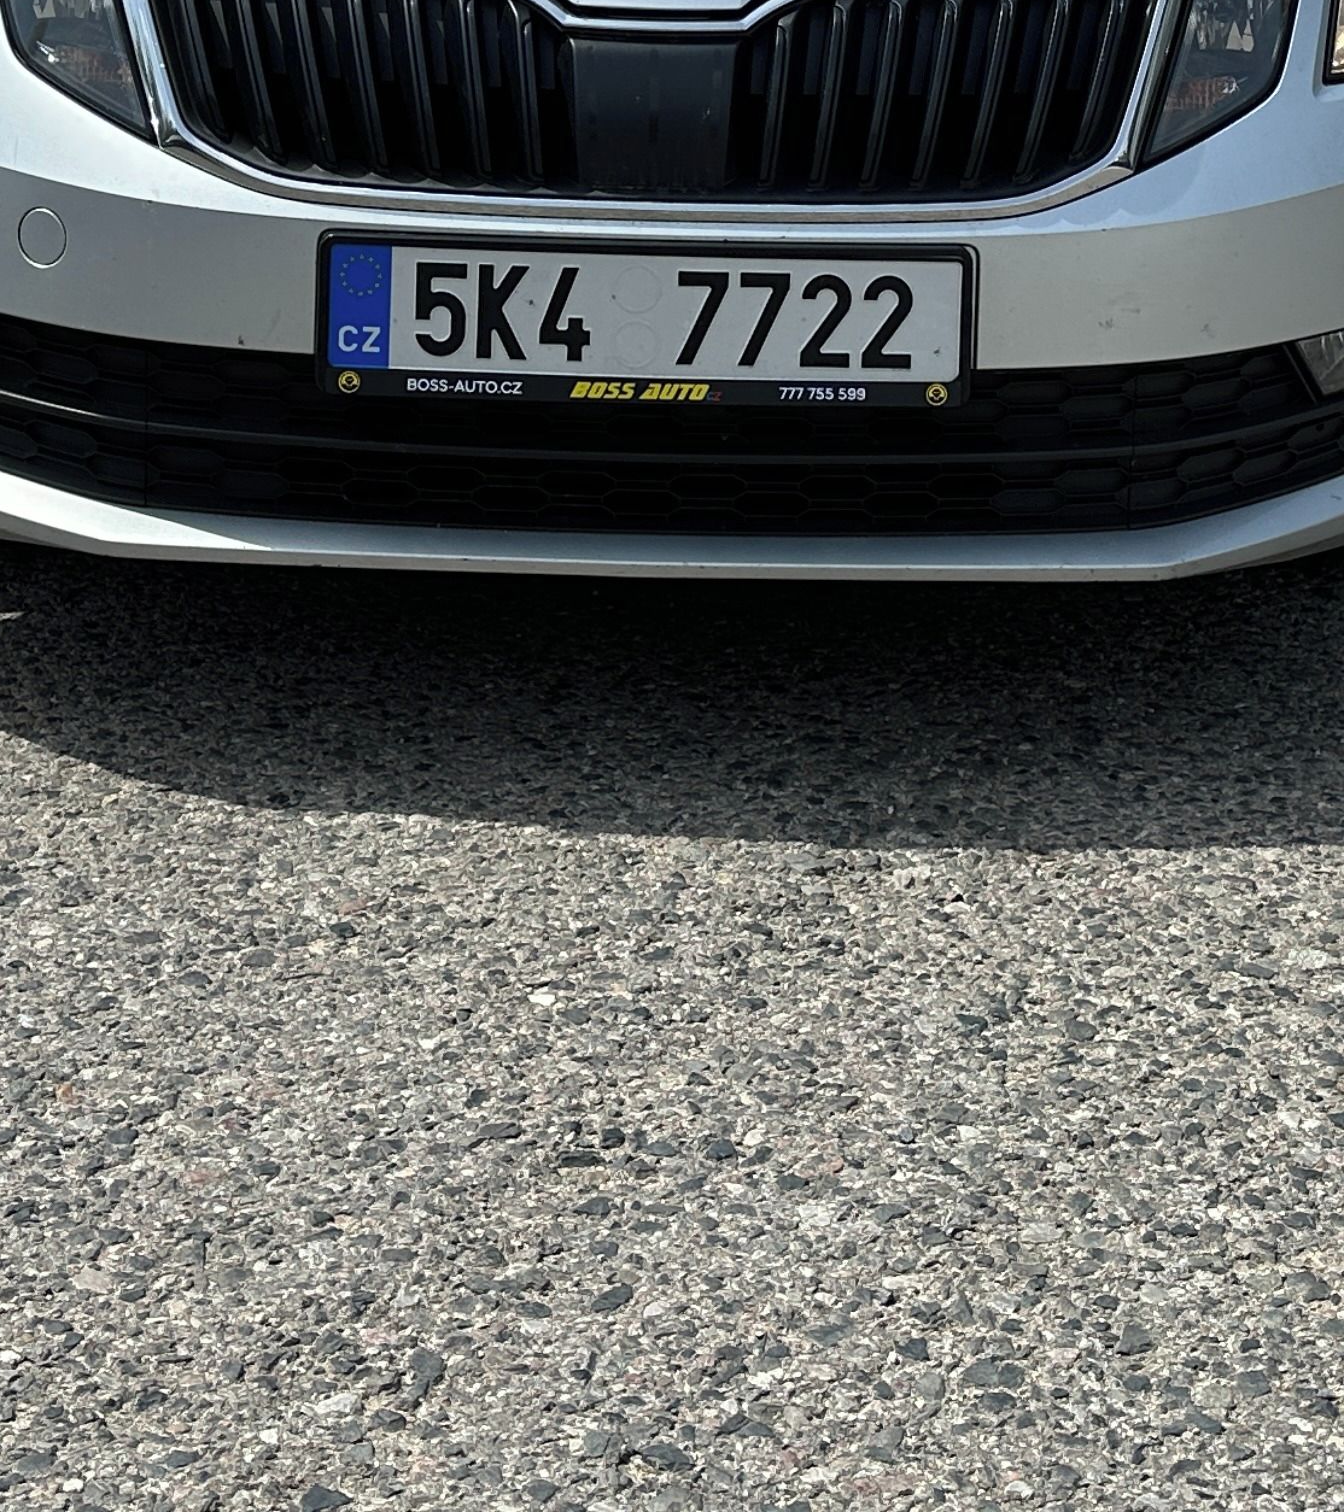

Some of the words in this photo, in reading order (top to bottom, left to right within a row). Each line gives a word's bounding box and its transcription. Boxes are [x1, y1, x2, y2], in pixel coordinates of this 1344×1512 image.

[415, 262, 591, 361] 5K4
[676, 271, 913, 370] 7722
[338, 325, 381, 353] CZ
[407, 378, 523, 395] BOSS-AUTO.CZ
[570, 381, 636, 399] BOSS
[639, 383, 710, 401] AUTO
[779, 387, 804, 400] 777
[808, 388, 834, 401] 755
[838, 388, 866, 401] 599
